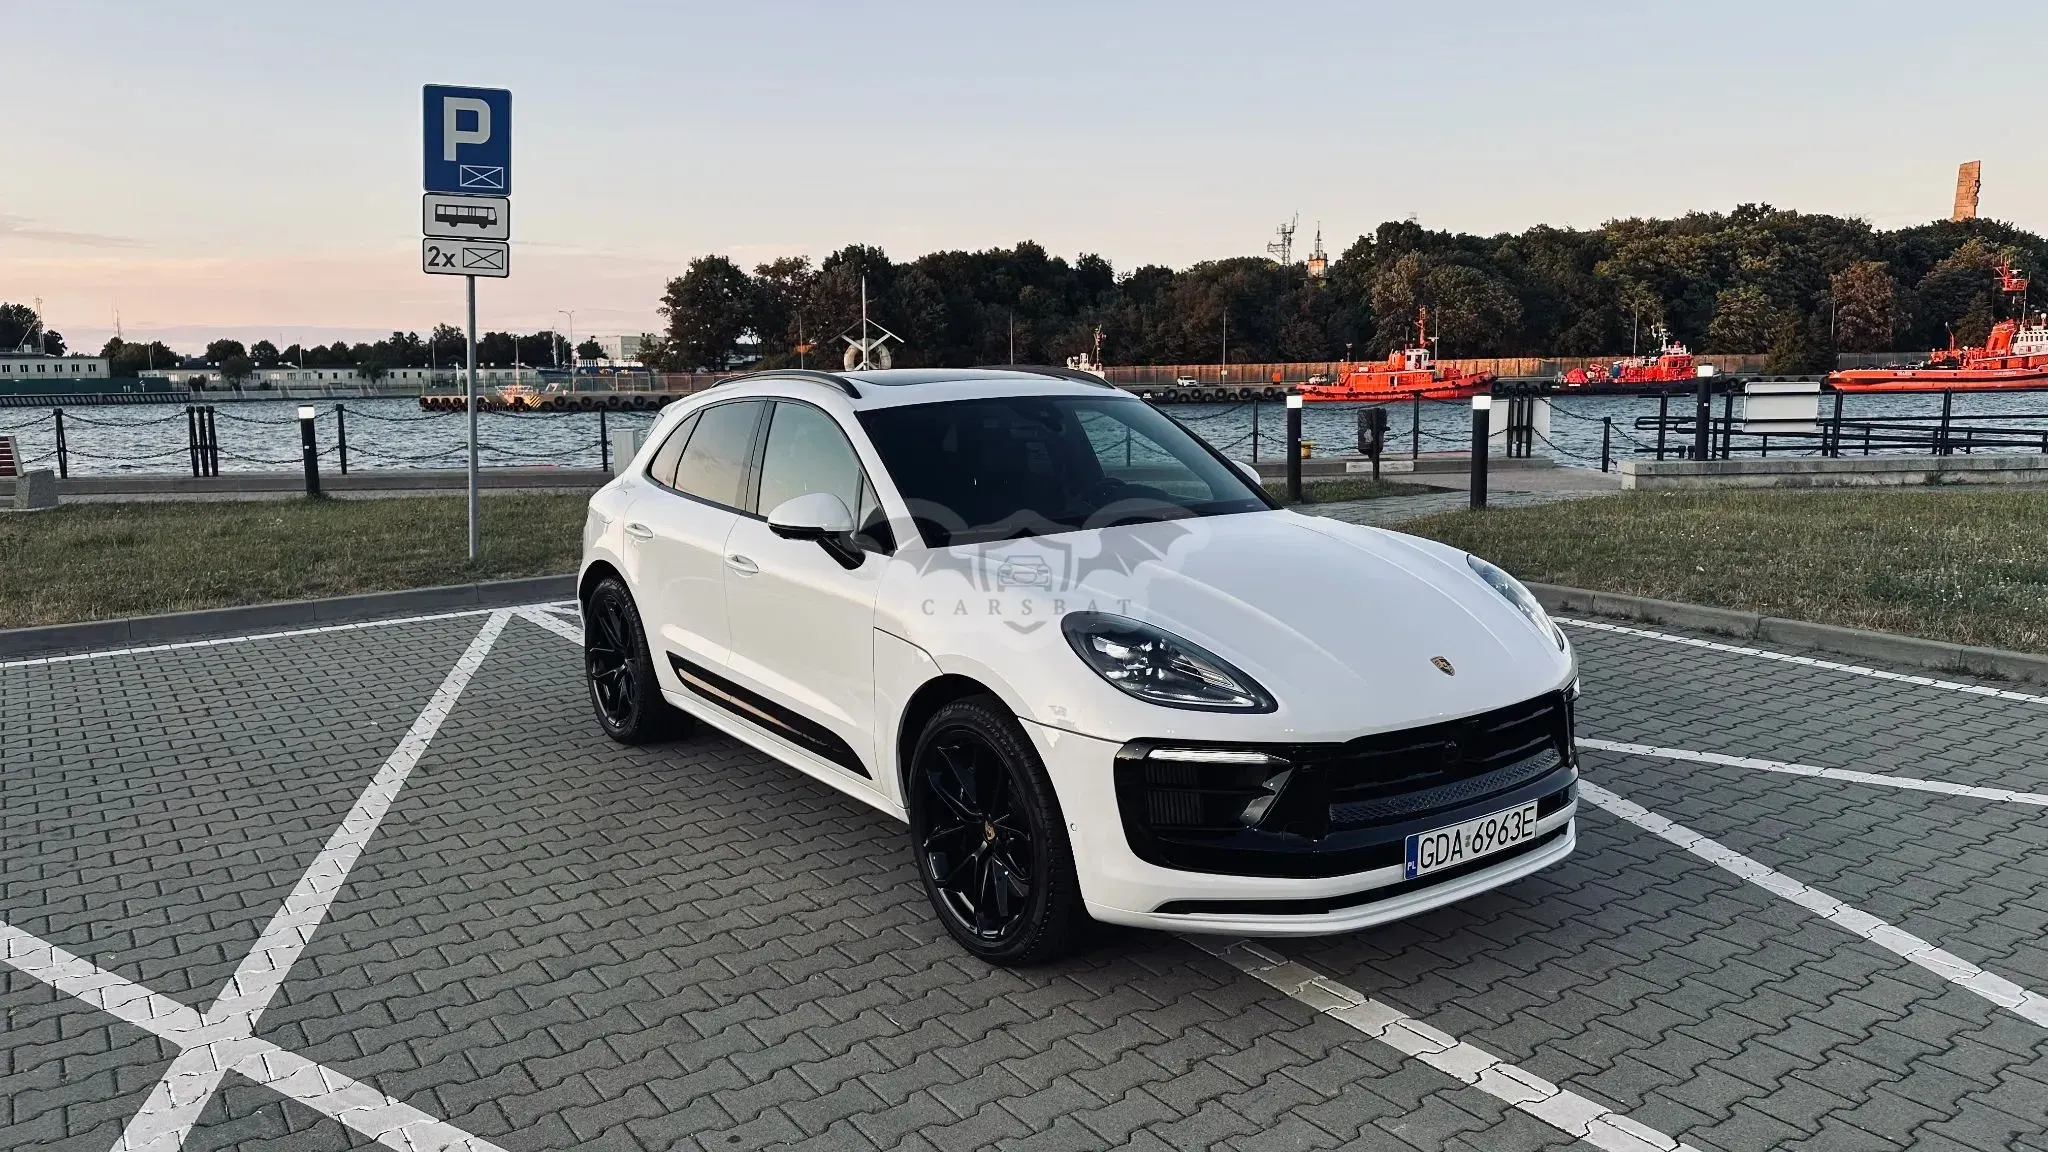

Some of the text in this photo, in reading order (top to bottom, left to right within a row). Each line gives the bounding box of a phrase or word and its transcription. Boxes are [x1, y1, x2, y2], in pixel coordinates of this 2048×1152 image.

[444, 96, 491, 161] P
[427, 246, 456, 268] 2x
[1407, 861, 1416, 871] PL
